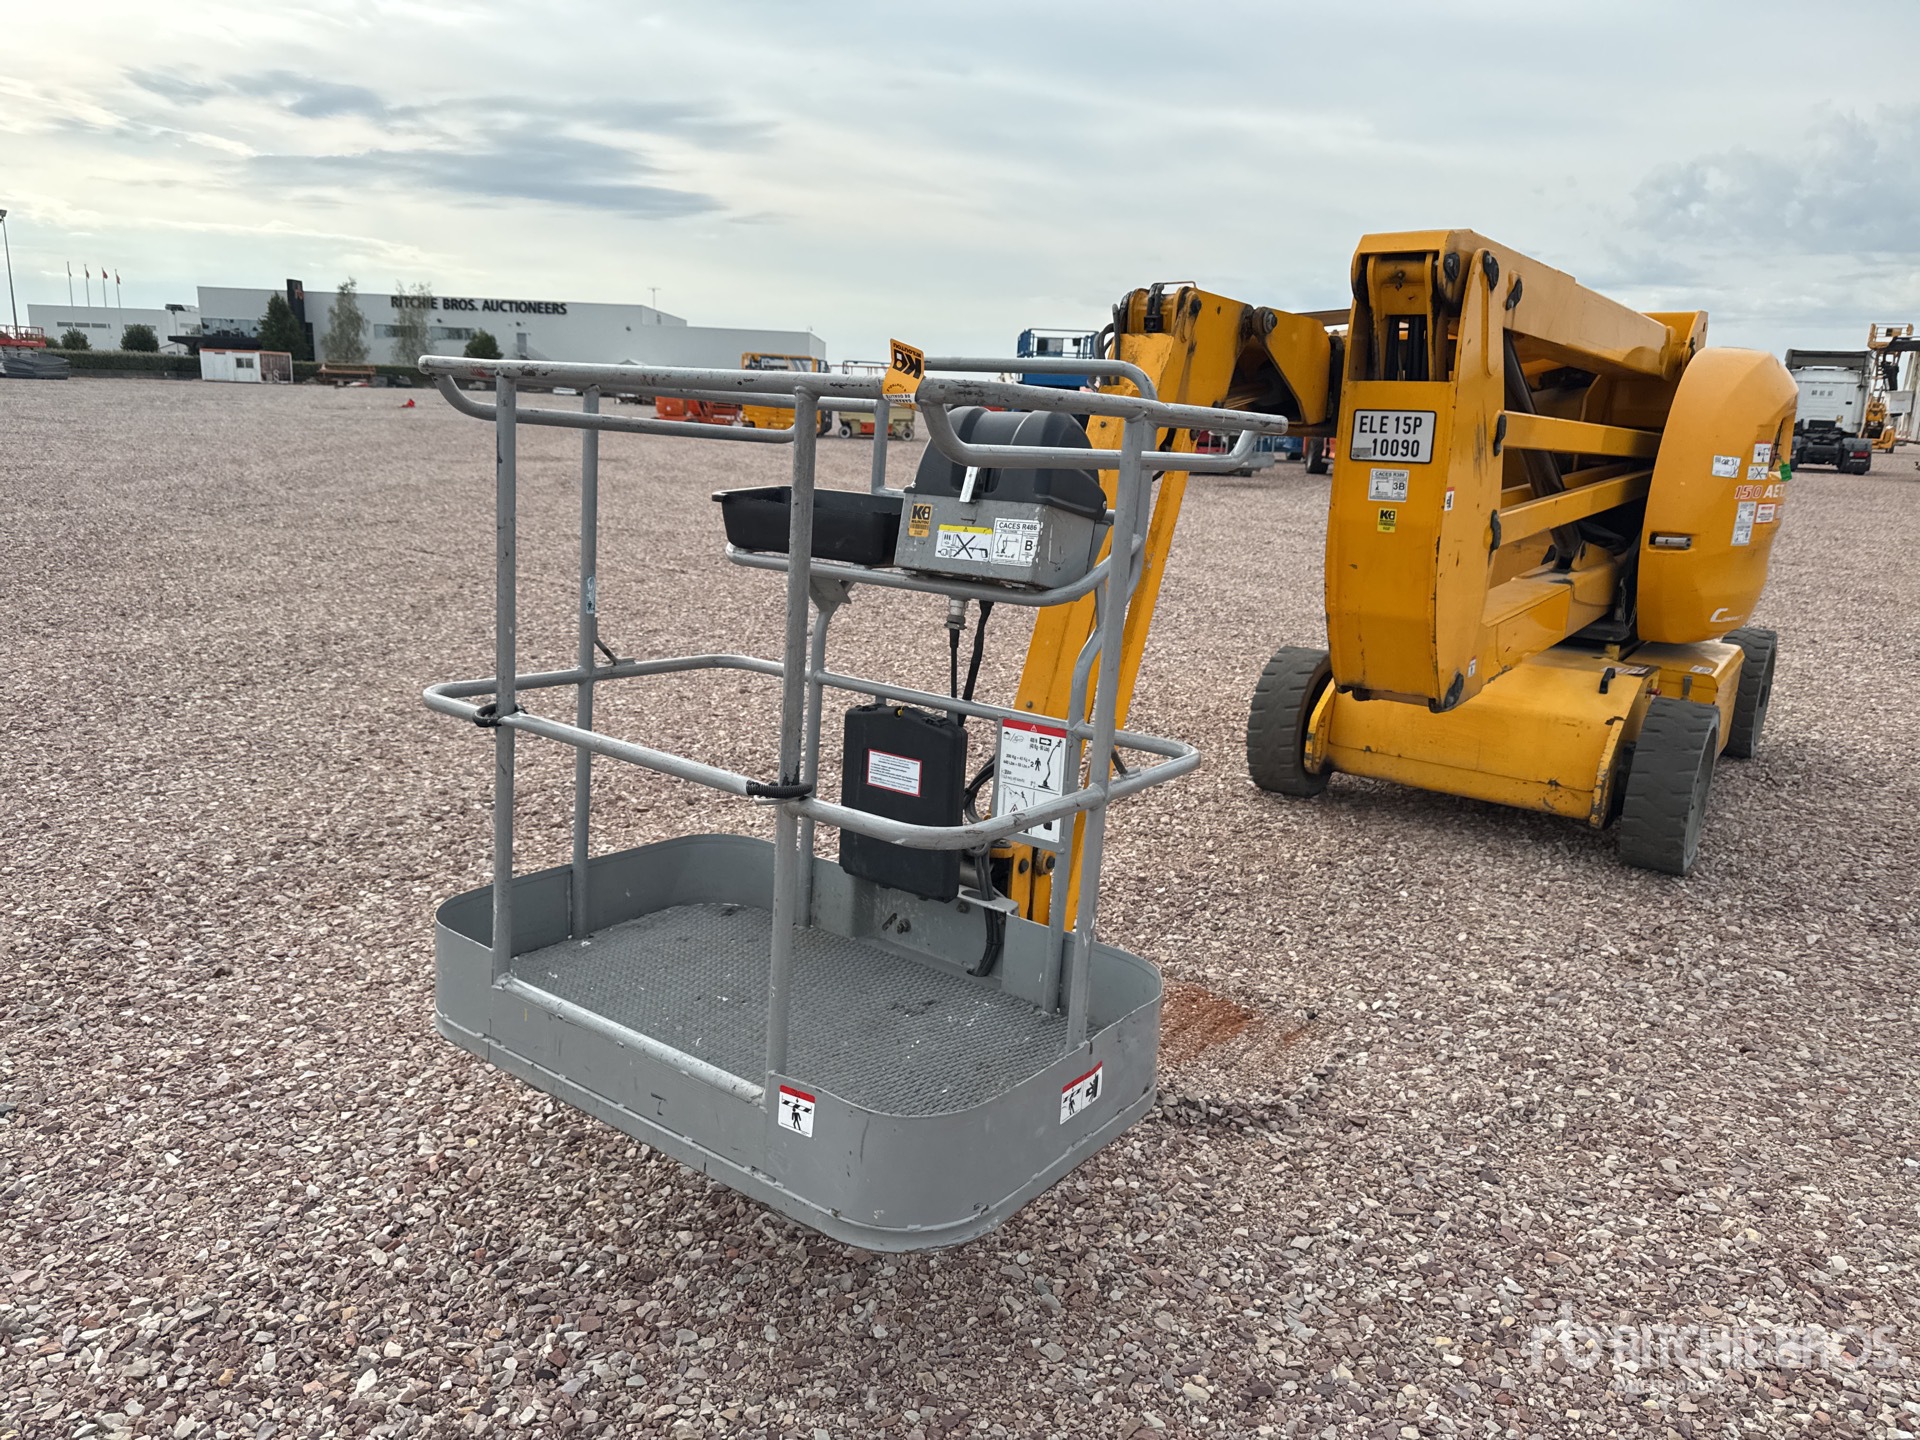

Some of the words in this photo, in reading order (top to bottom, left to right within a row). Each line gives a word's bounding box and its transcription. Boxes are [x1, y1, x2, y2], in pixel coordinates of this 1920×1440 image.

[390, 295, 438, 310] RITCHIE
[442, 298, 478, 311] BROS.
[482, 299, 567, 315] AUCTIONEERS
[1359, 415, 1389, 433] ELE
[1395, 416, 1422, 435] 15P
[1372, 438, 1420, 458] 10090
[1392, 482, 1406, 491] 3B
[1734, 485, 1763, 499] 150
[998, 522, 1021, 530] CACES
[1025, 540, 1034, 551] B
